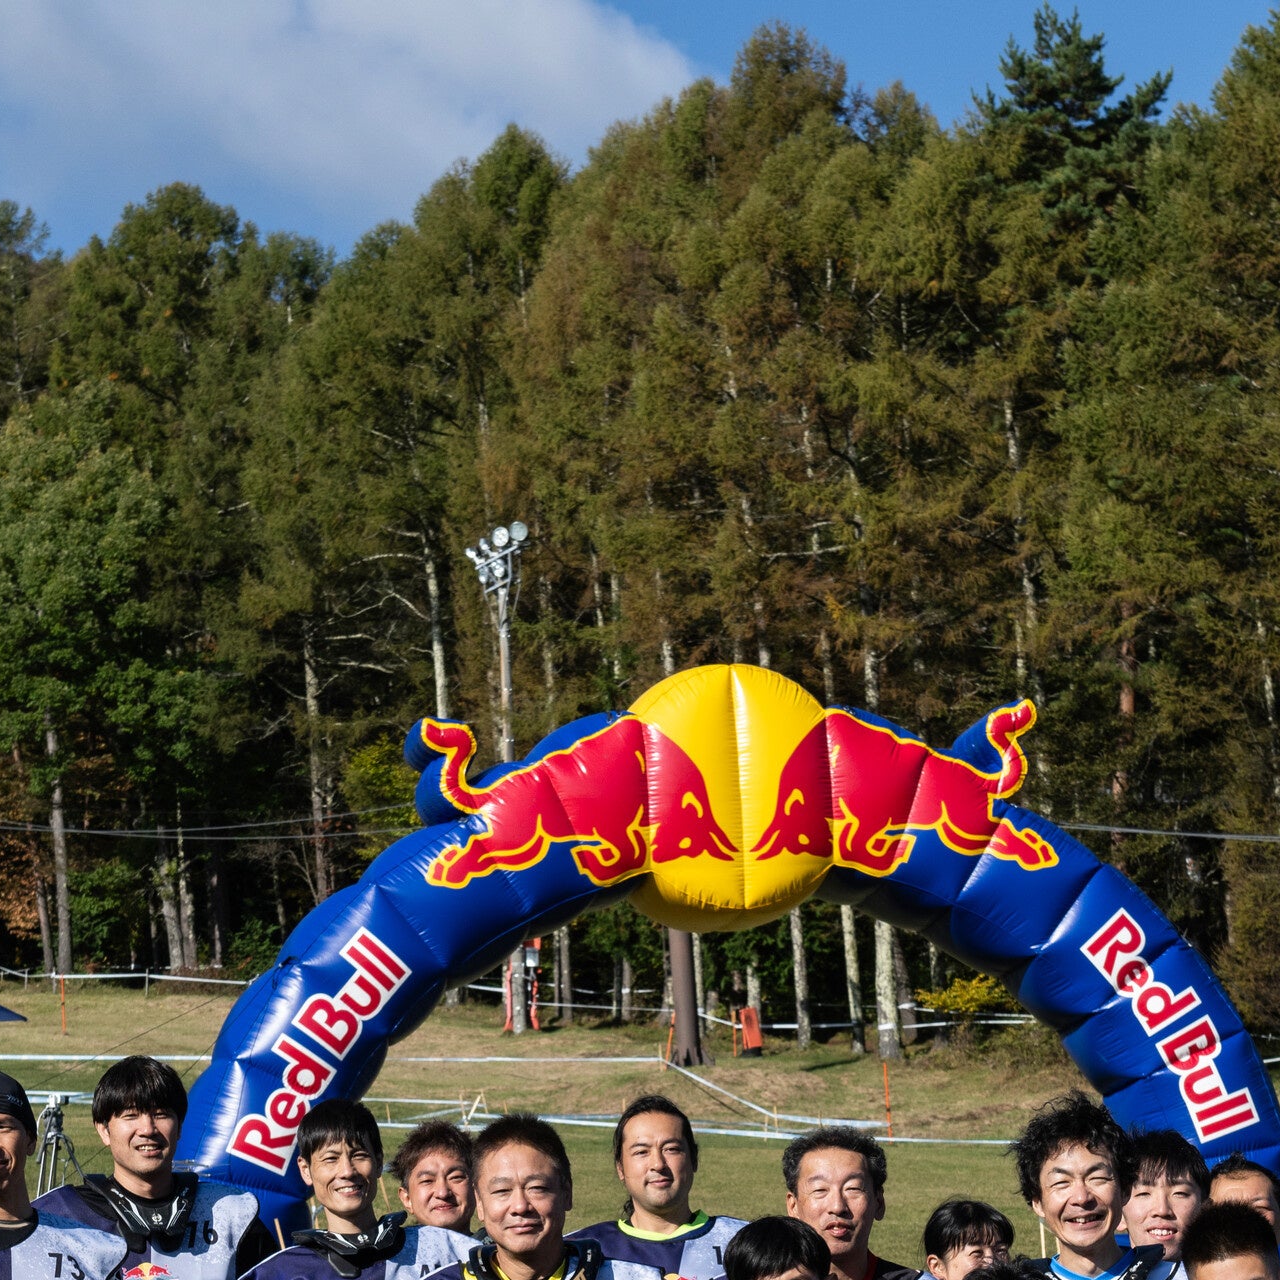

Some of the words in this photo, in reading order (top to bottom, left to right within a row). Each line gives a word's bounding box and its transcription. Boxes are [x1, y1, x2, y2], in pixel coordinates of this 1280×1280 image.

[228, 1036, 335, 1174] Red
[294, 929, 410, 1059] Bull
[1082, 909, 1200, 1035] Red
[1158, 1016, 1258, 1141] Bull
